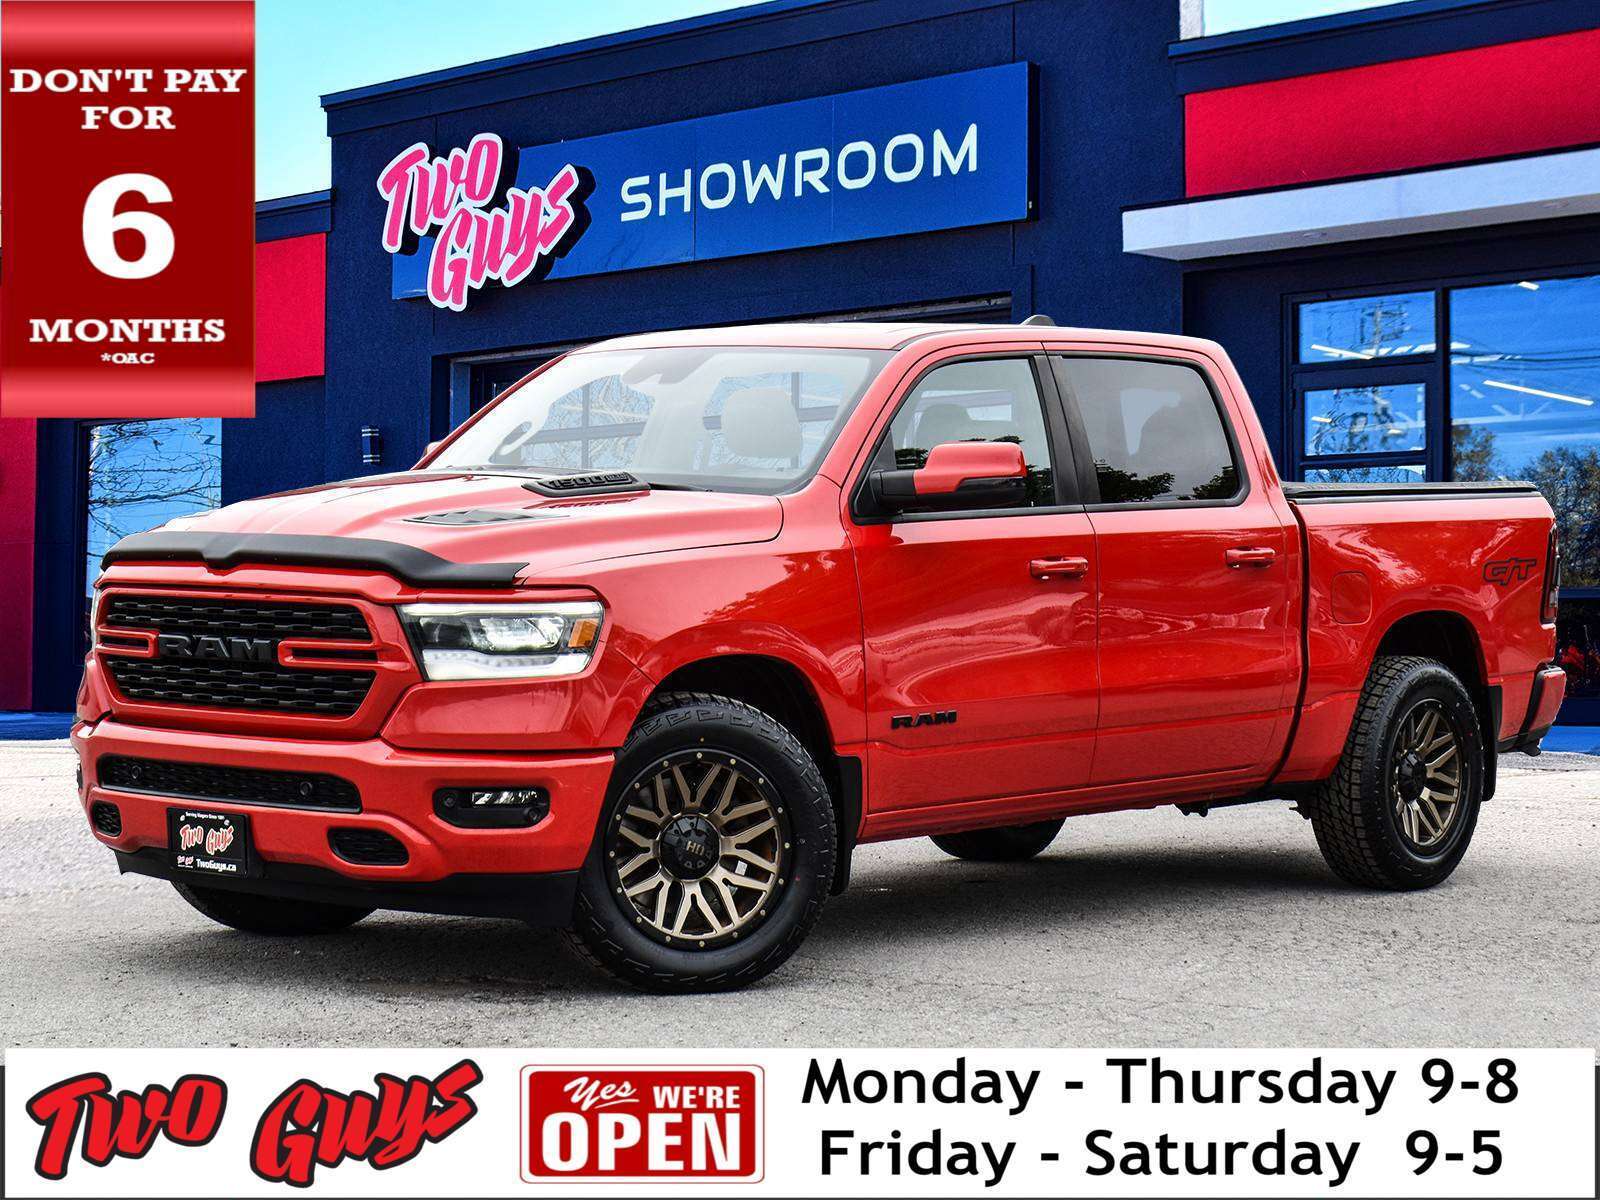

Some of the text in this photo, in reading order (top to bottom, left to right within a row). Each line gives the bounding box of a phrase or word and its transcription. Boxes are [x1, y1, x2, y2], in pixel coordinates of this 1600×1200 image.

[620, 123, 977, 222] SHOWROOM
[158, 633, 272, 661] RAM
[891, 710, 957, 729] RAM
[196, 858, 237, 872] TwoGuys.ca
